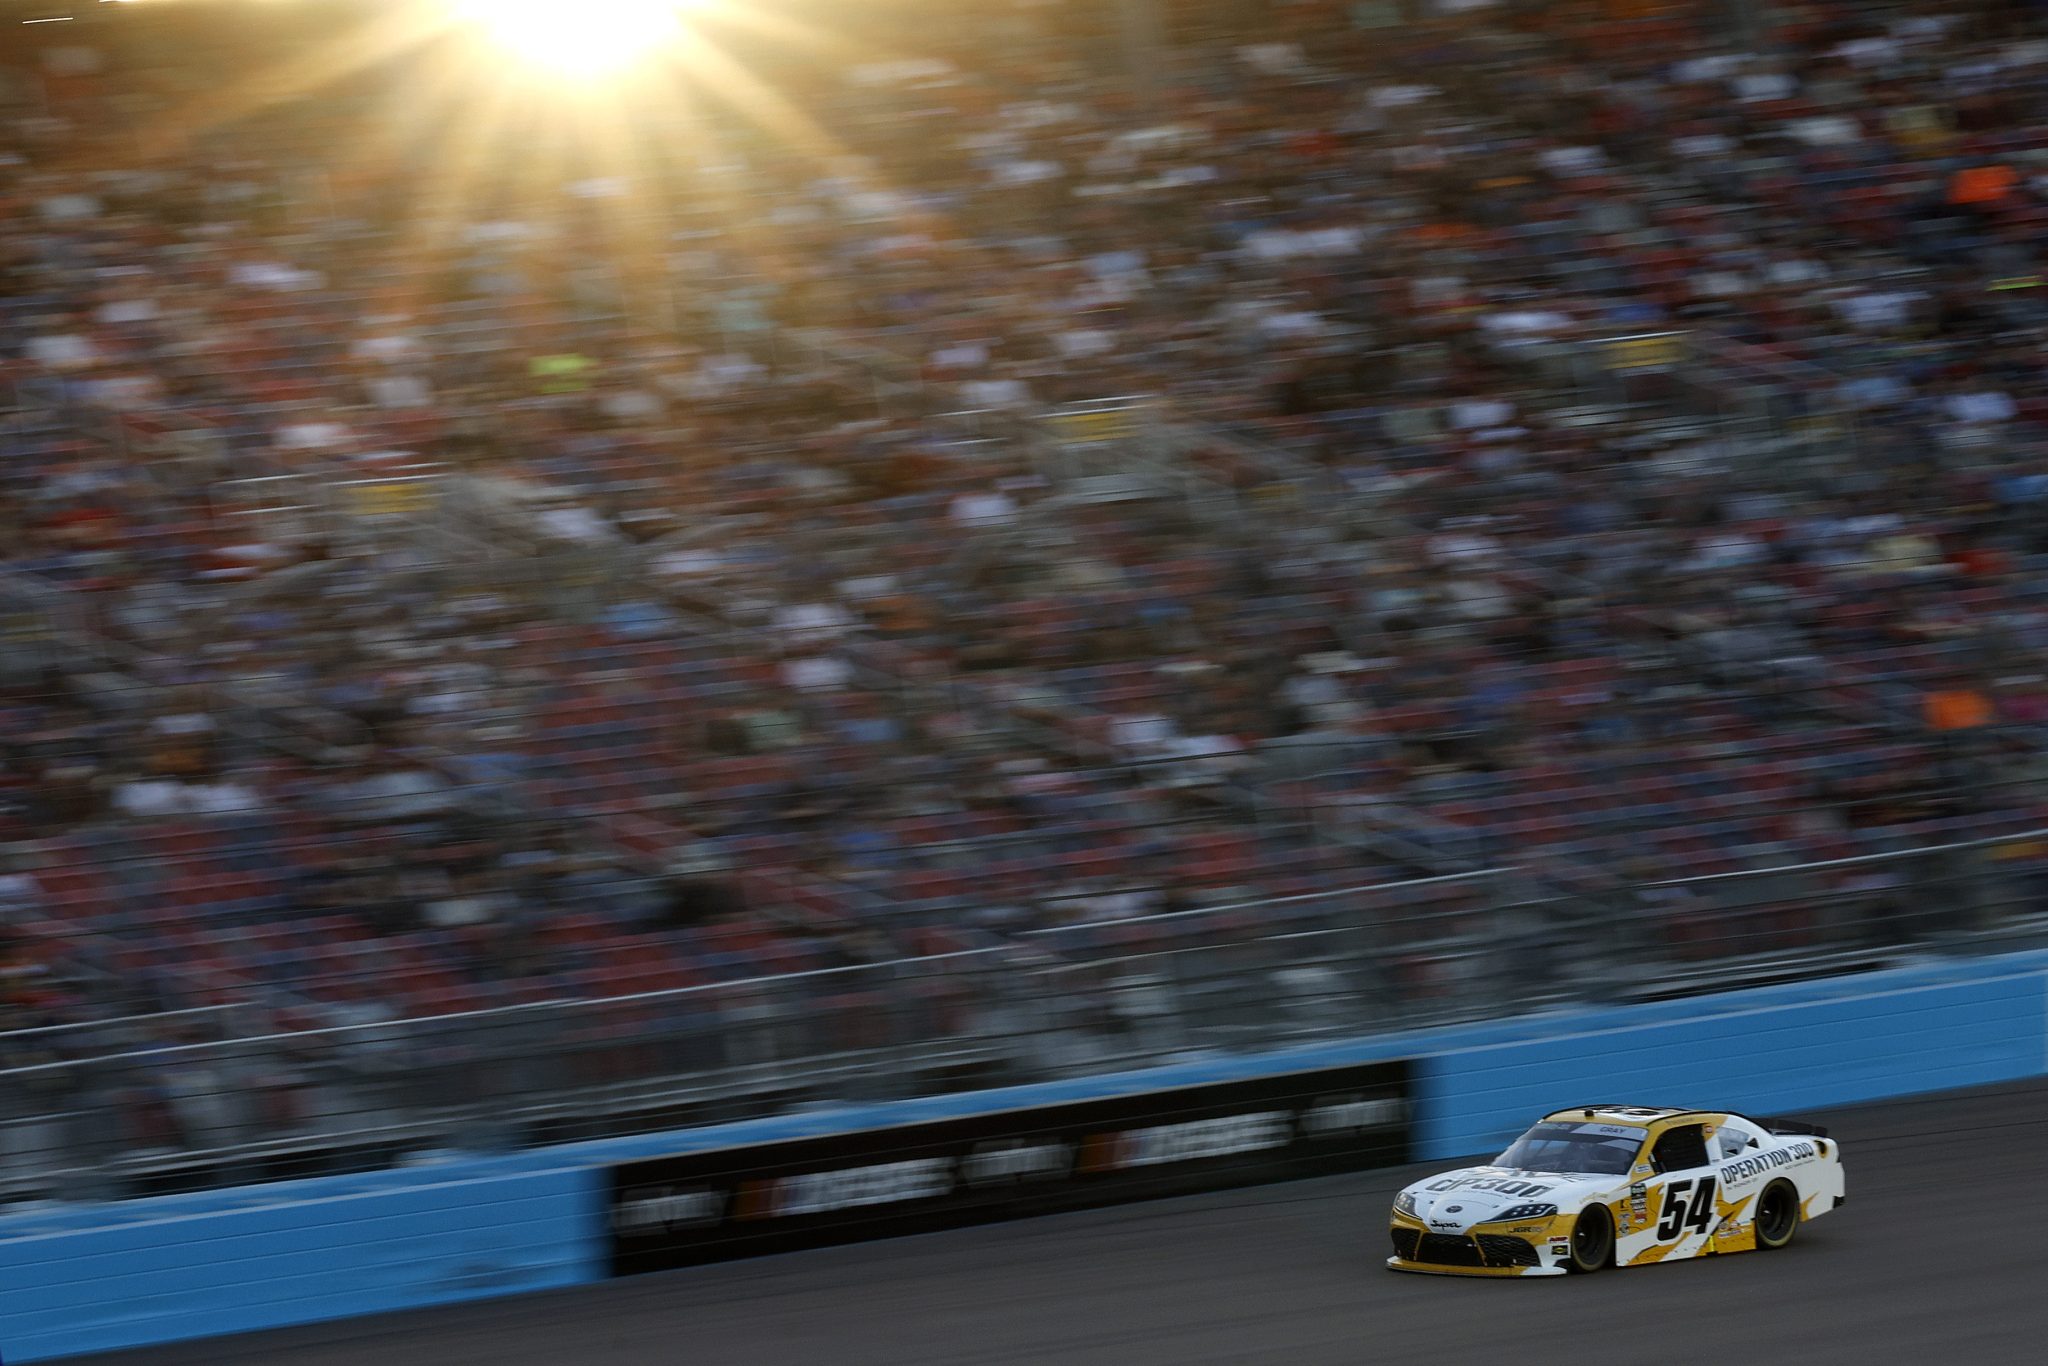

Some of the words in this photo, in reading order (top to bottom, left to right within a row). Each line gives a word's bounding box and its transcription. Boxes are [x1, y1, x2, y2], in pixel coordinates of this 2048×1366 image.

[1720, 1148, 1792, 1184] OPERATION
[1789, 1142, 1815, 1160] 300
[1430, 1220, 1462, 1230] Supra
[1657, 1175, 1716, 1241] 54
